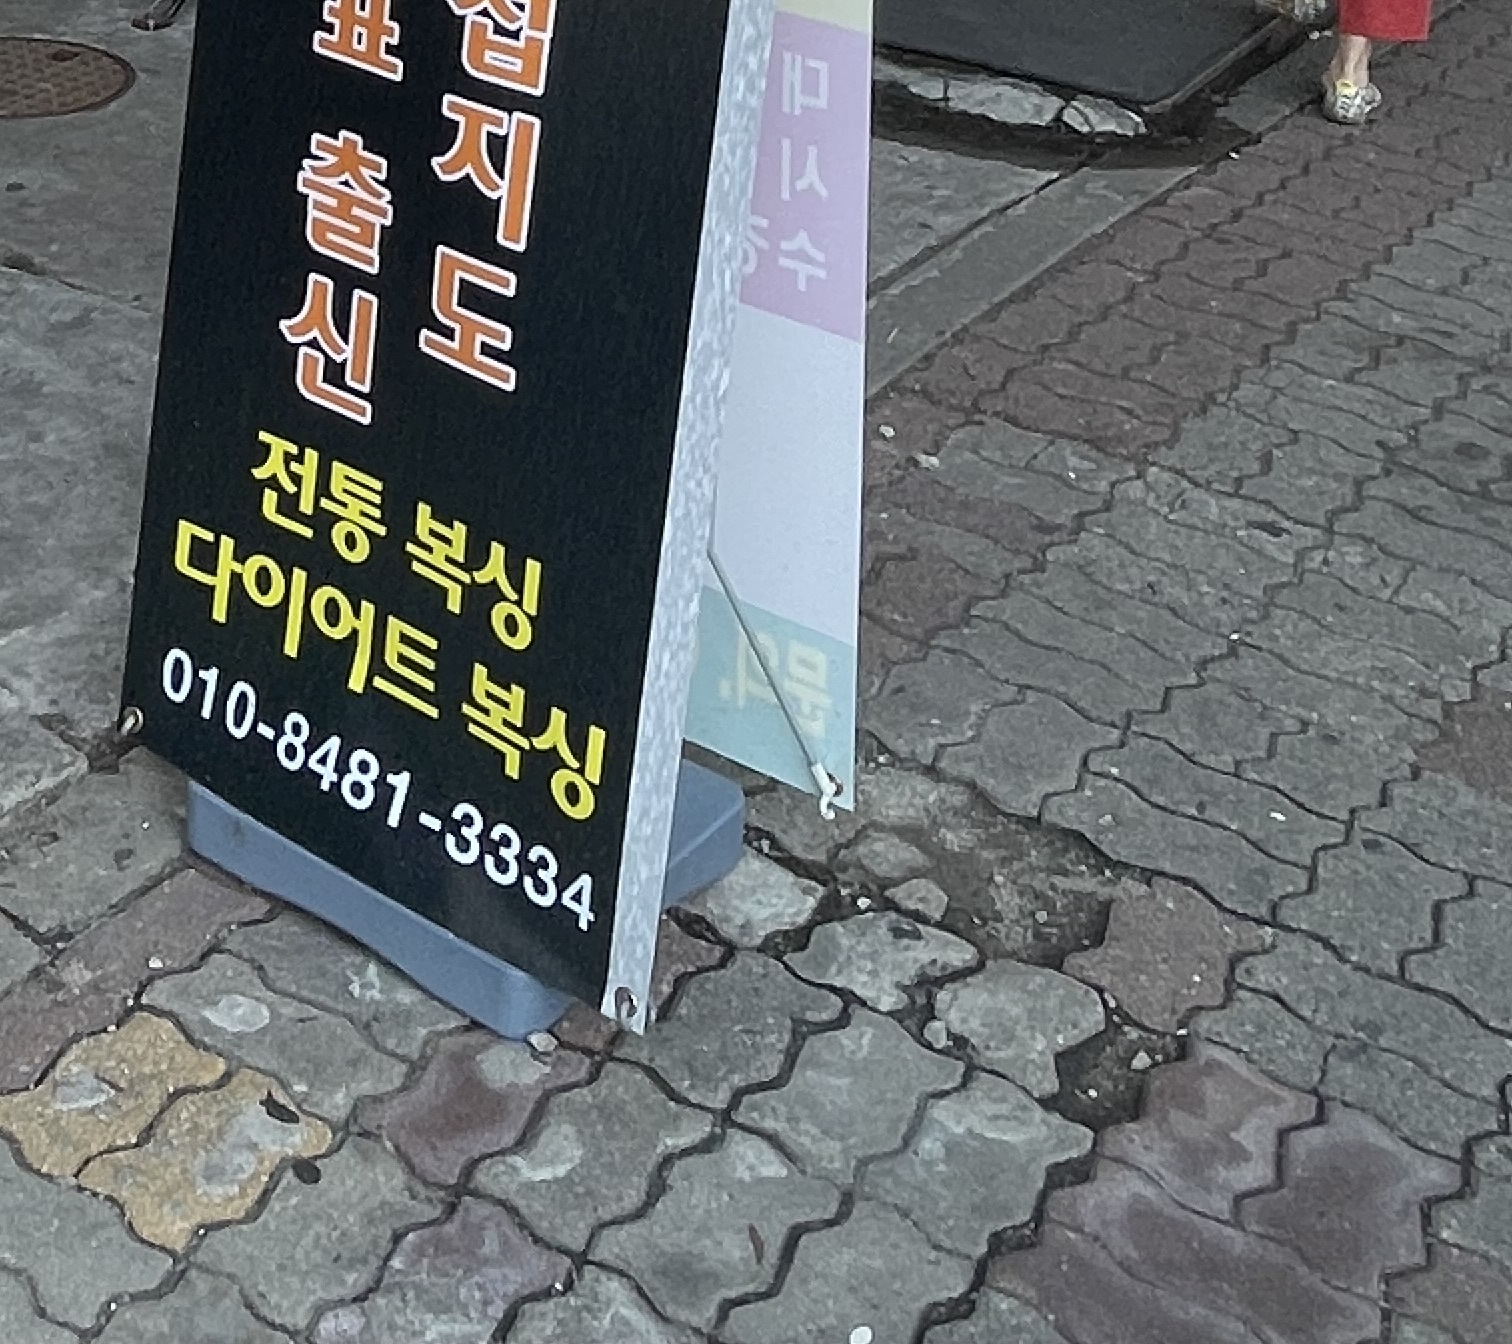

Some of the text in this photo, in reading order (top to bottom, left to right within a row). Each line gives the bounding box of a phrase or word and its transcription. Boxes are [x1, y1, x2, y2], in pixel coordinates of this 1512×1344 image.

[278, 129, 395, 426] 출신
[173, 518, 609, 822] 다이어트 복싱
[250, 429, 544, 653] 전통 복싱
[161, 646, 597, 933] 010-8481-3334
